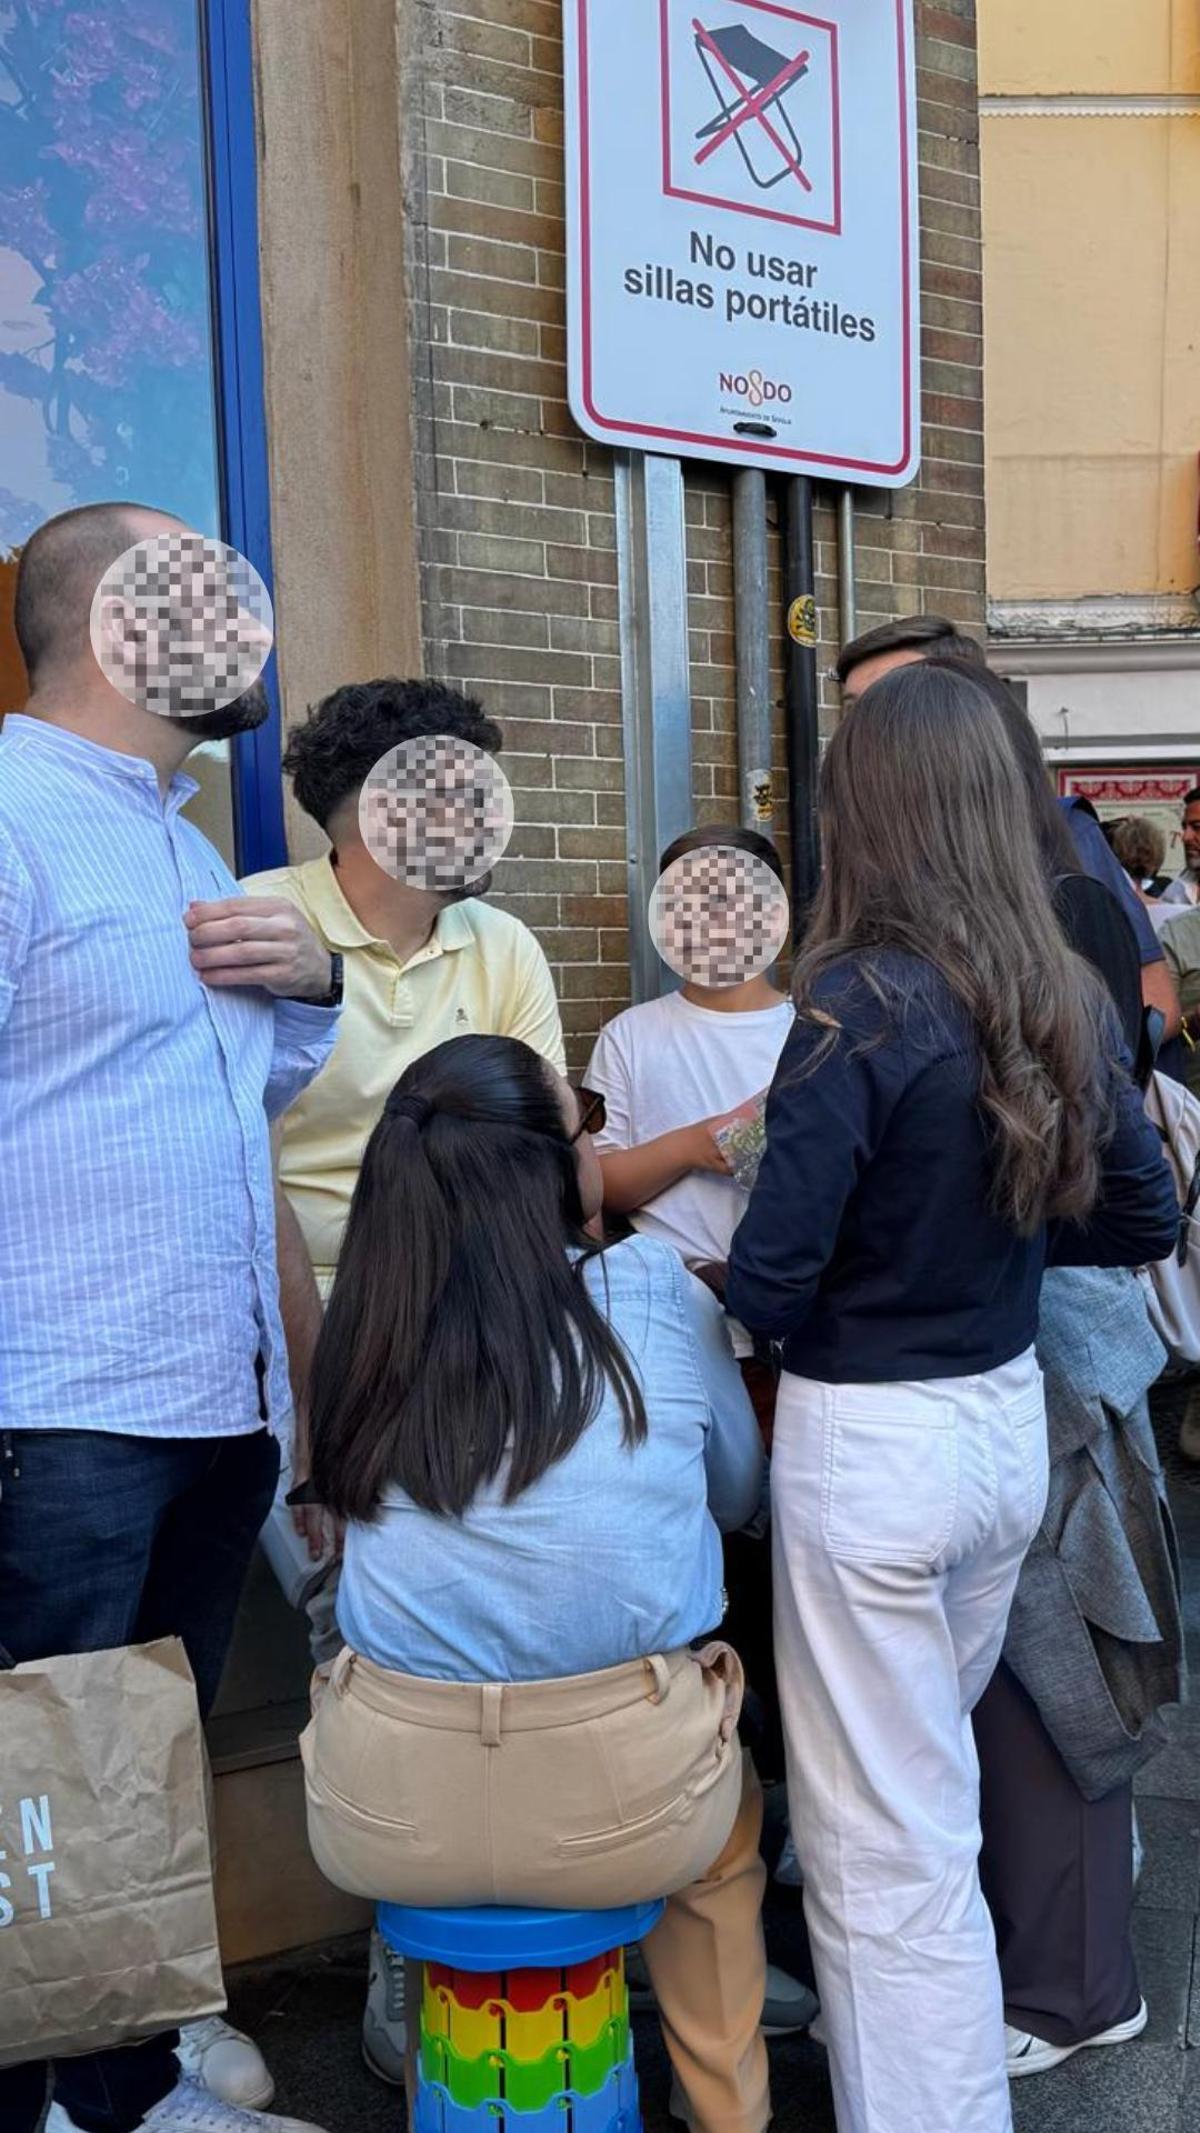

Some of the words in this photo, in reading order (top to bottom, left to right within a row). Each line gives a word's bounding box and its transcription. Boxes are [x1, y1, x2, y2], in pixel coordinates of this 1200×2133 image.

[690, 230, 736, 271] No
[747, 251, 818, 289] usar
[624, 263, 714, 309] sillas
[726, 289, 875, 342] portátiles
